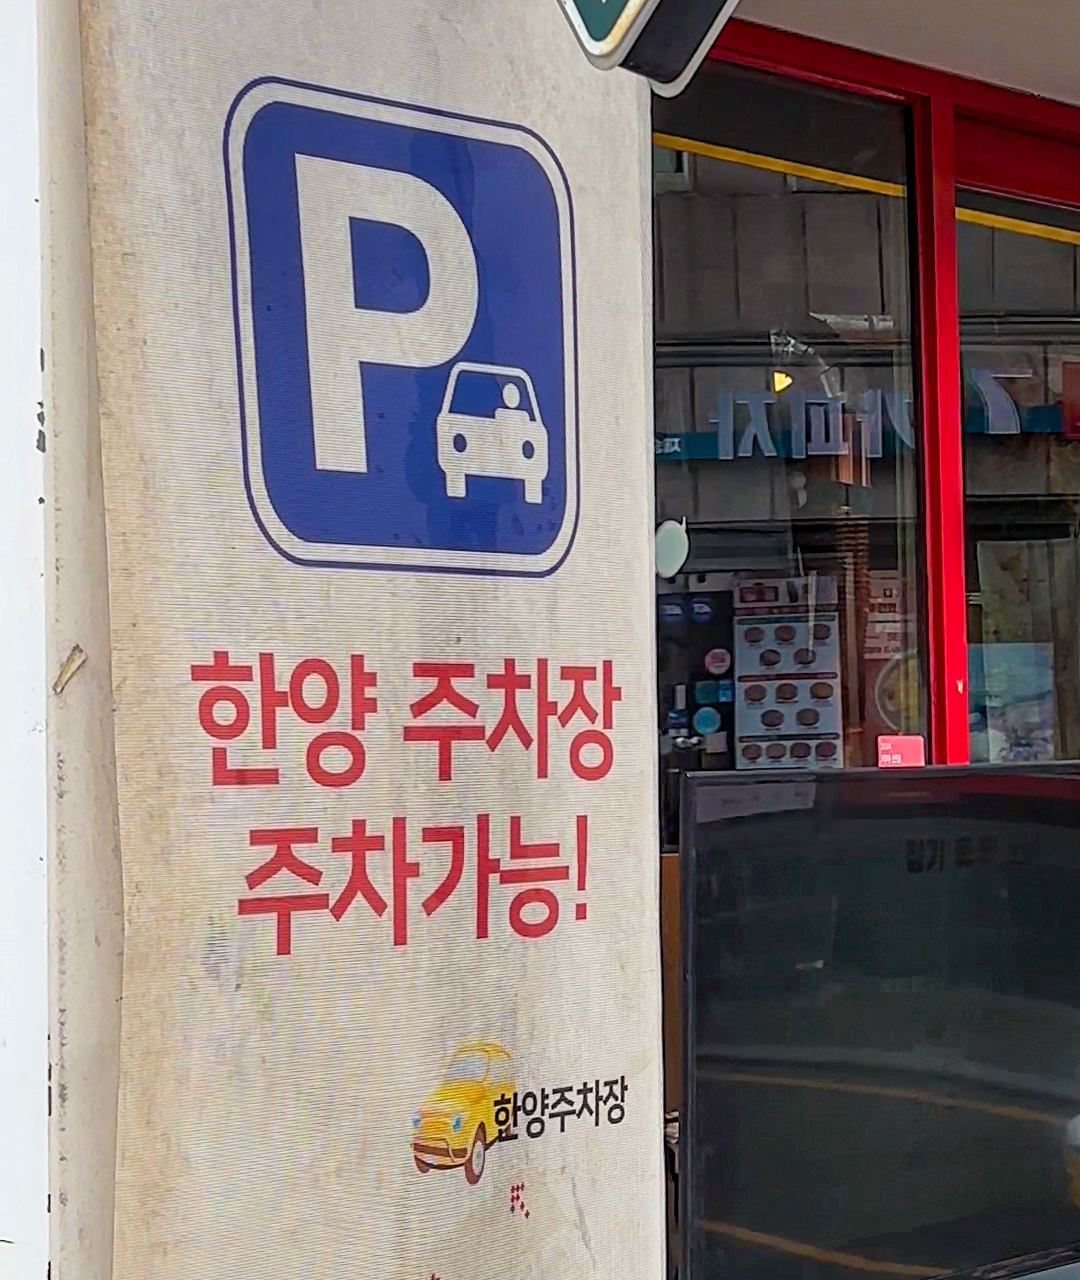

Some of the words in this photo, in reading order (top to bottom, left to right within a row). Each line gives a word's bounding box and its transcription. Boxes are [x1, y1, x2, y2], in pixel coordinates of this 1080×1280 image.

[293, 152, 479, 474] P
[190, 650, 378, 788] 한양
[403, 657, 623, 783] 주차장
[237, 813, 588, 956] 주차가능!
[493, 1075, 629, 1143] 한양주차장
